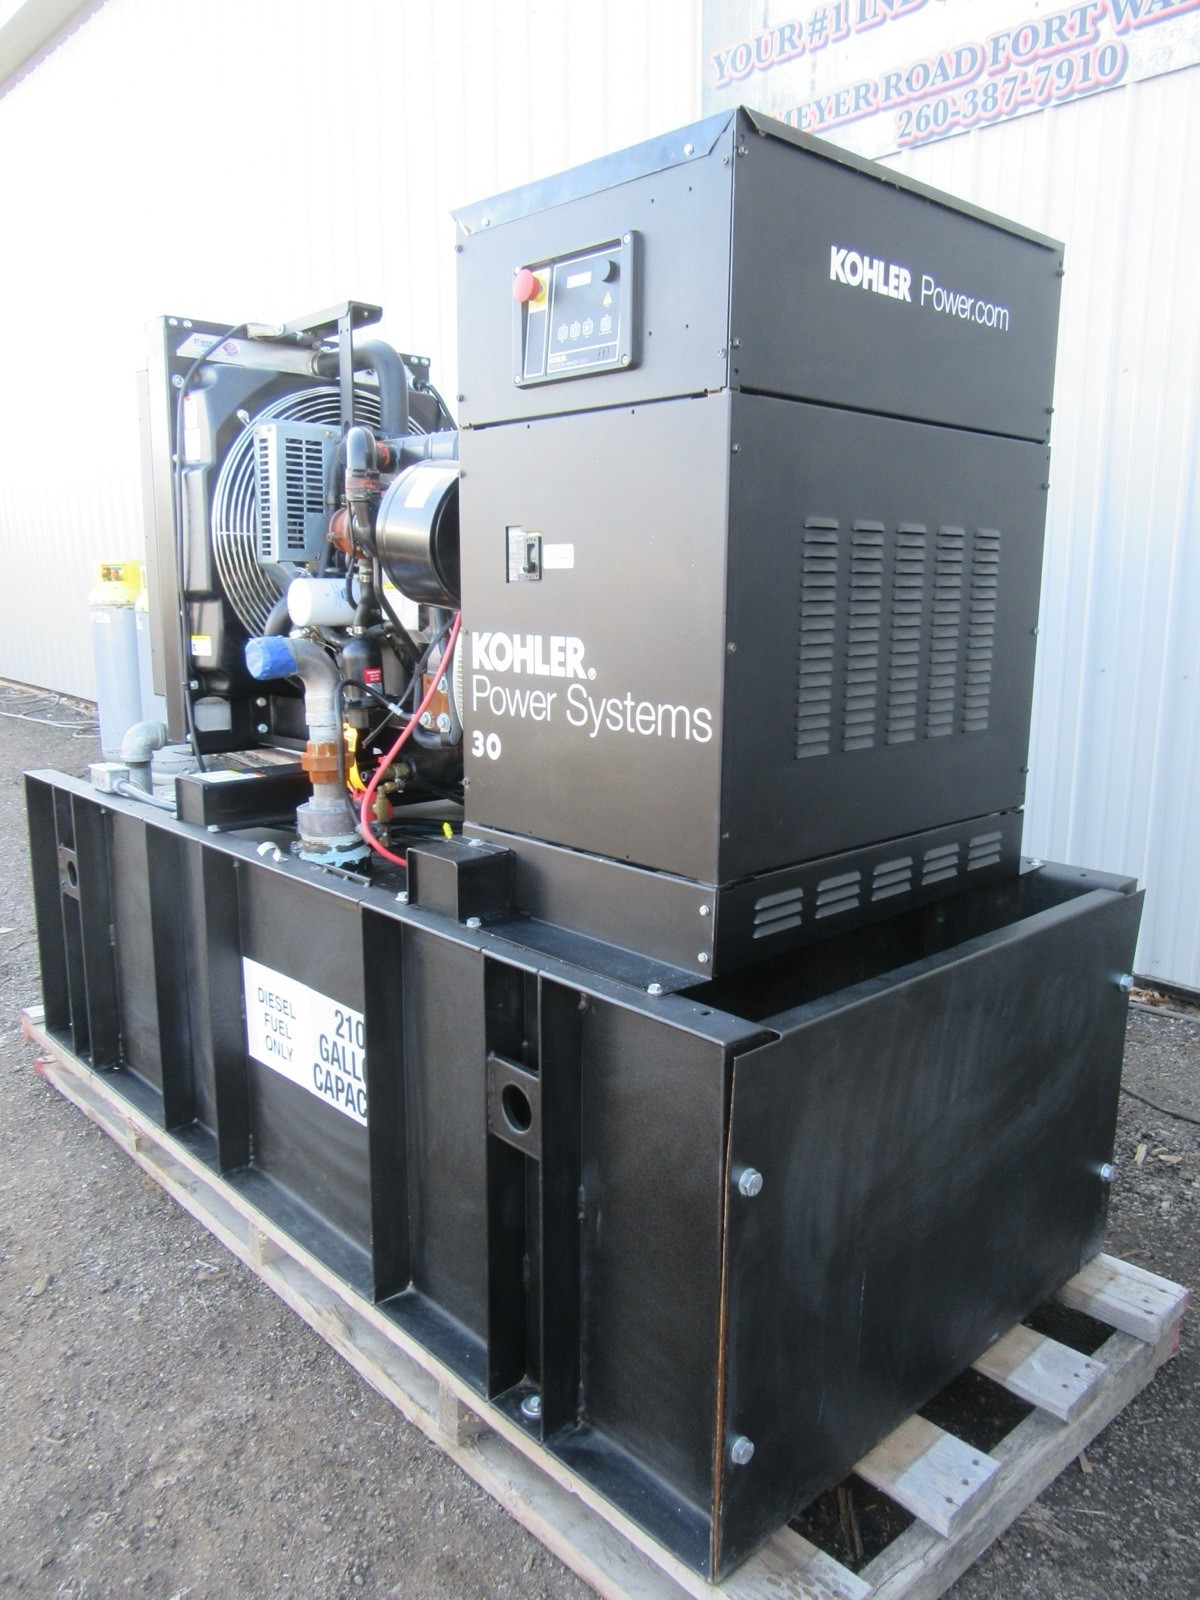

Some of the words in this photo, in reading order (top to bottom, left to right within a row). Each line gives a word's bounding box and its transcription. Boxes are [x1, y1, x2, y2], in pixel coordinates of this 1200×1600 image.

[711, 21, 801, 84] YOUR
[807, 1, 847, 45] #1
[881, 45, 981, 103] ROAD
[987, 3, 1098, 68] FORT
[896, 43, 1120, 140] 260-387-7910
[830, 245, 912, 303] KOHLER
[920, 274, 1009, 331] Power.com
[472, 674, 557, 721] Power
[566, 683, 713, 743] Systems
[472, 730, 502, 761] 30
[257, 986, 297, 1020] DIESEL
[264, 1012, 292, 1040] FUEL
[334, 1009, 365, 1050] 210
[265, 1034, 294, 1063] ONLY
